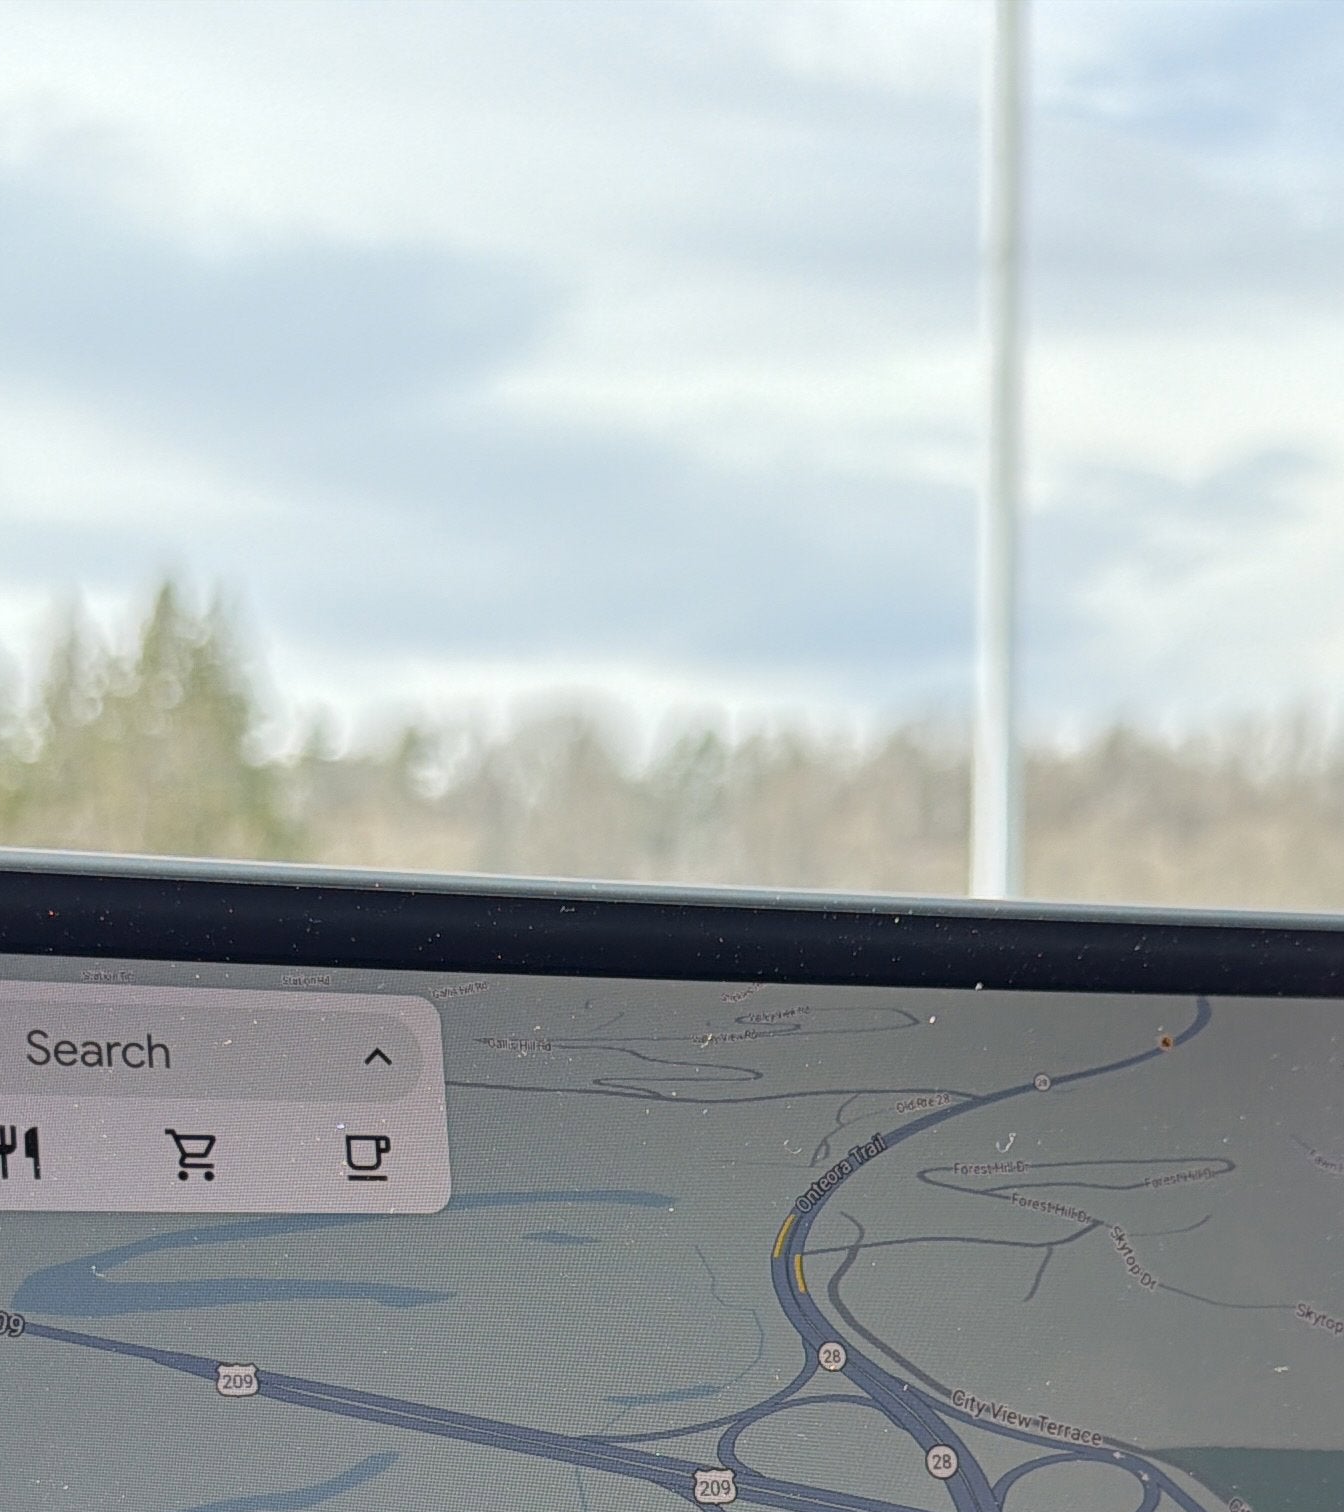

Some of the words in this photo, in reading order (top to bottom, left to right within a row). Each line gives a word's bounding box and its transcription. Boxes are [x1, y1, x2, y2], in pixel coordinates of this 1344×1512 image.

[25, 1030, 171, 1069] Search
[794, 1157, 854, 1215] Onteora
[848, 1132, 887, 1167] Trail
[953, 1162, 992, 1176] Forest
[1011, 1192, 1054, 1215] Forest
[1055, 1202, 1077, 1220] Hill
[1077, 1209, 1093, 1225] Dr
[1109, 1225, 1142, 1277] Skytop
[1139, 1271, 1158, 1291] Dr
[1295, 1302, 1344, 1336] Skytop
[822, 1349, 843, 1364] 28
[222, 1373, 254, 1391] 209
[952, 1388, 988, 1418] City
[990, 1403, 1033, 1429] View
[1037, 1415, 1103, 1448] Terrace
[931, 1453, 953, 1470] 28
[699, 1479, 732, 1497] 209
